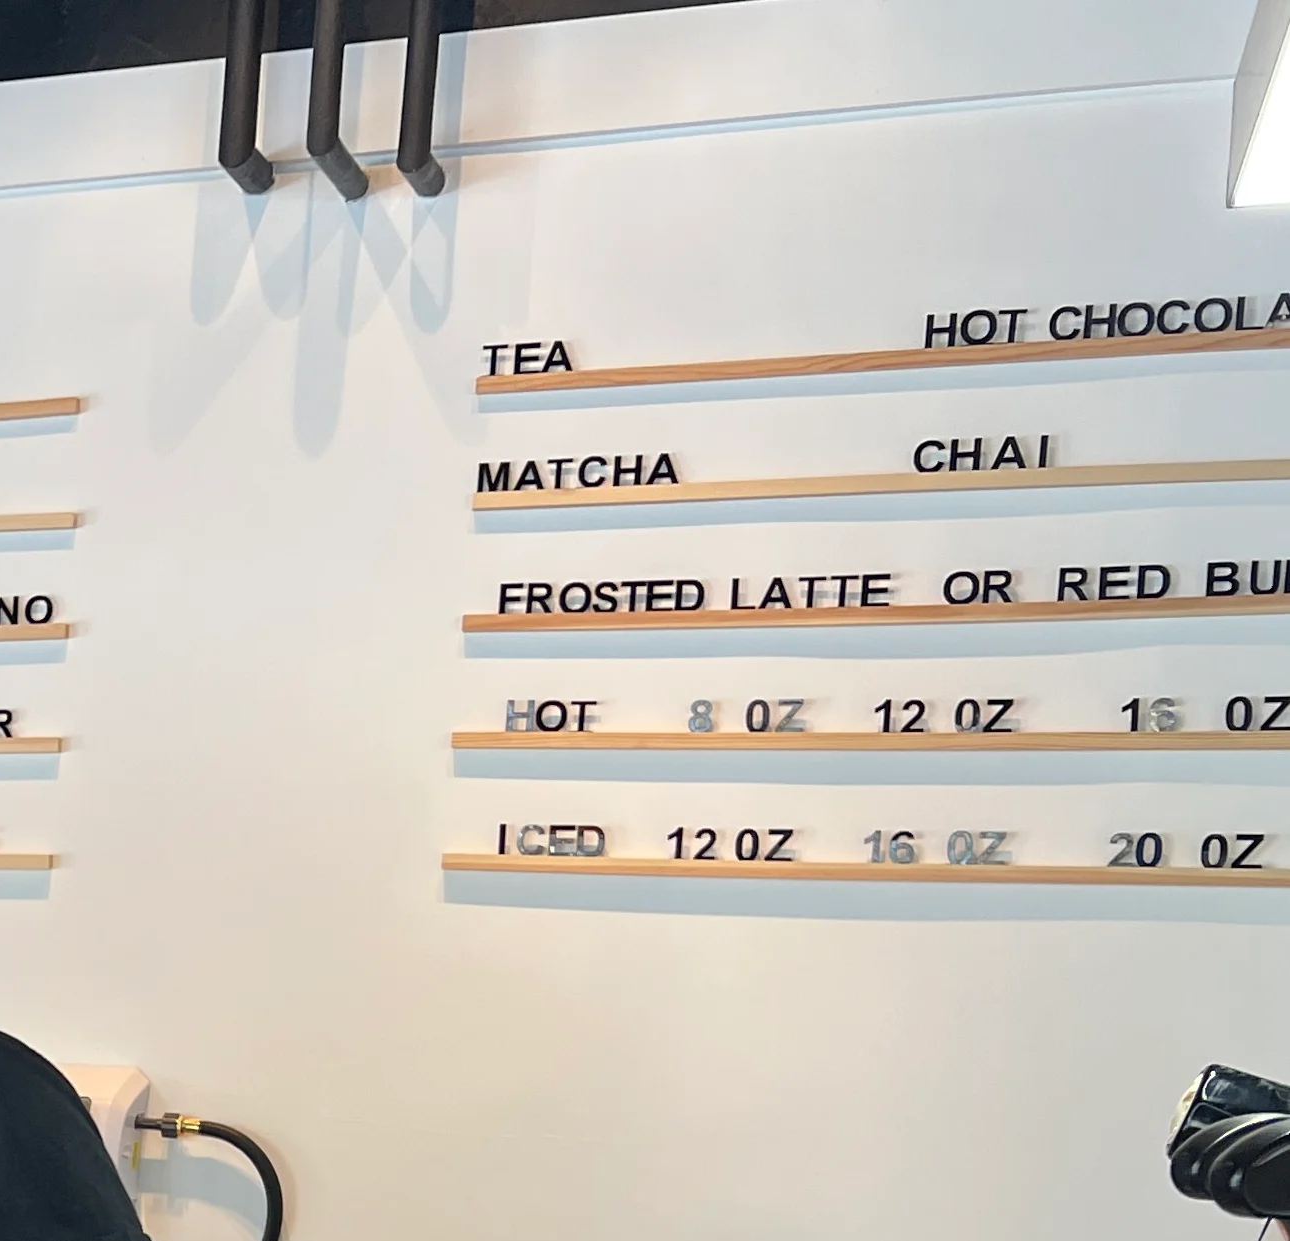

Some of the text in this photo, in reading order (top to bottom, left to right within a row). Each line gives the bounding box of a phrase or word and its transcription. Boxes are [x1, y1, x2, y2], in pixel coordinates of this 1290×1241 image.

[925, 293, 1290, 349] HOT CHOCOLA
[483, 340, 573, 377] TEA
[476, 453, 679, 494] MATCHA
[913, 434, 1050, 473] CHAI
[498, 579, 705, 615] FROSTED
[730, 573, 893, 610] LATTE
[942, 570, 1014, 605] OR
[1057, 565, 1171, 602] RED
[505, 699, 597, 733] HOT
[688, 699, 714, 733] 8
[874, 699, 926, 733] 12
[1121, 697, 1177, 733] 16
[498, 823, 606, 857] ICED
[667, 827, 717, 860] 12
[863, 830, 916, 864] 16
[1107, 832, 1164, 868] 20
